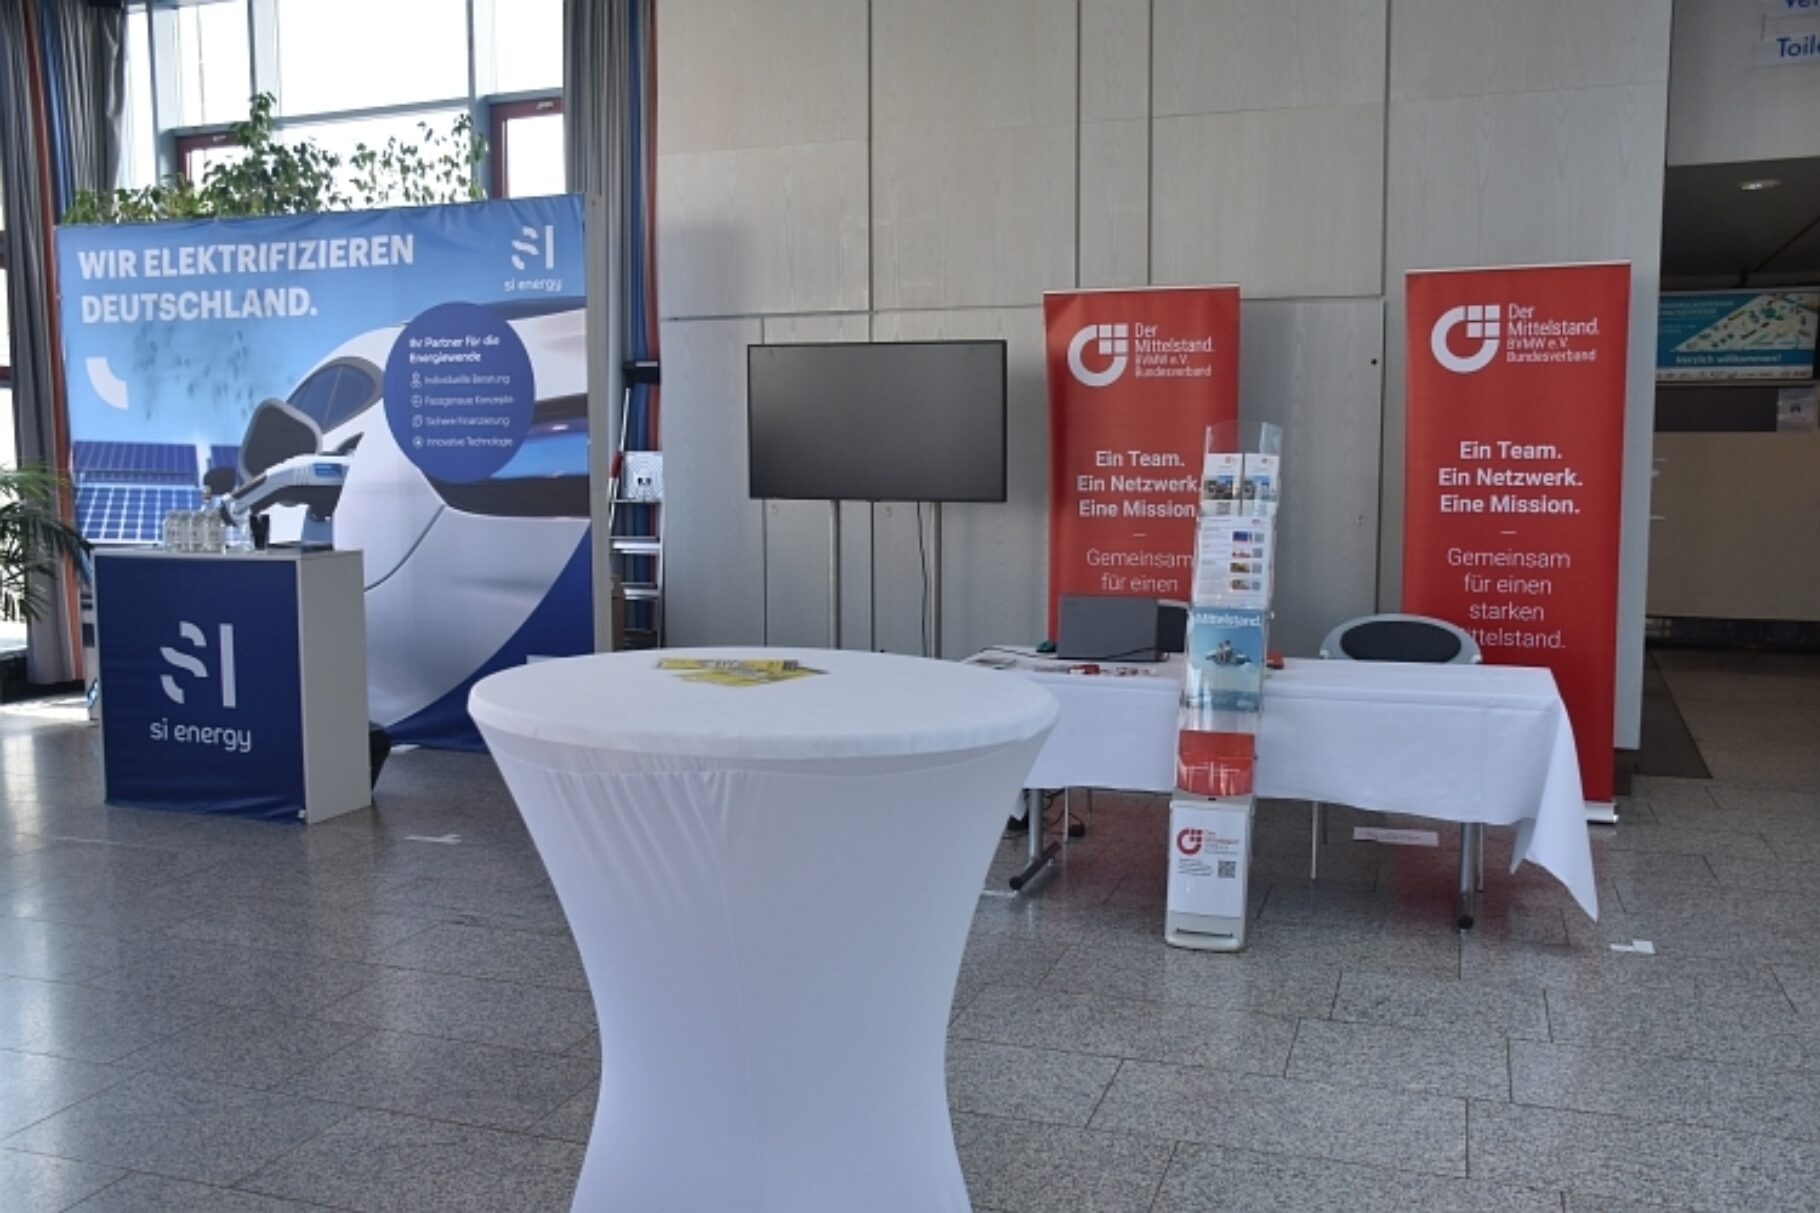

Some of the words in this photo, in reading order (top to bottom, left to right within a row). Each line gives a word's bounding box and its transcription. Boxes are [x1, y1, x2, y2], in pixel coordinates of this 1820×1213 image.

[1776, 34, 1820, 59] Toil
[78, 250, 137, 280] WIR
[145, 234, 415, 278] ELEKTRIFIZIEREN
[518, 278, 562, 292] energy
[82, 287, 319, 324] DEUTSCHLAND.
[1508, 302, 1535, 319] Der
[1135, 322, 1158, 338] Der
[424, 336, 464, 348] Partner
[482, 334, 500, 346] die
[409, 351, 481, 364] Energiewende
[1507, 348, 1596, 363] Bundesverband
[1135, 364, 1212, 378] Bundesverband
[1095, 450, 1124, 467] Ein
[1128, 450, 1185, 467] Team.
[1460, 440, 1491, 460] Ein
[1496, 440, 1563, 460] Team.
[1077, 475, 1105, 491] Ein
[1438, 467, 1470, 486] Ein
[1476, 467, 1583, 487] Netzwerk.
[1079, 499, 1118, 517] Eine
[1440, 494, 1484, 513] Eine
[1490, 494, 1581, 514] Mission.
[1086, 548, 1193, 569] Gemeinsam
[1447, 547, 1571, 569] Gemeinsam
[1101, 572, 1126, 591] für
[1130, 574, 1178, 593] einen
[1464, 572, 1491, 593] für
[1496, 574, 1552, 595] einen
[1469, 601, 1545, 622] starken
[1469, 627, 1567, 649] ttelstand.
[150, 717, 168, 741] si
[174, 724, 252, 753] energy
